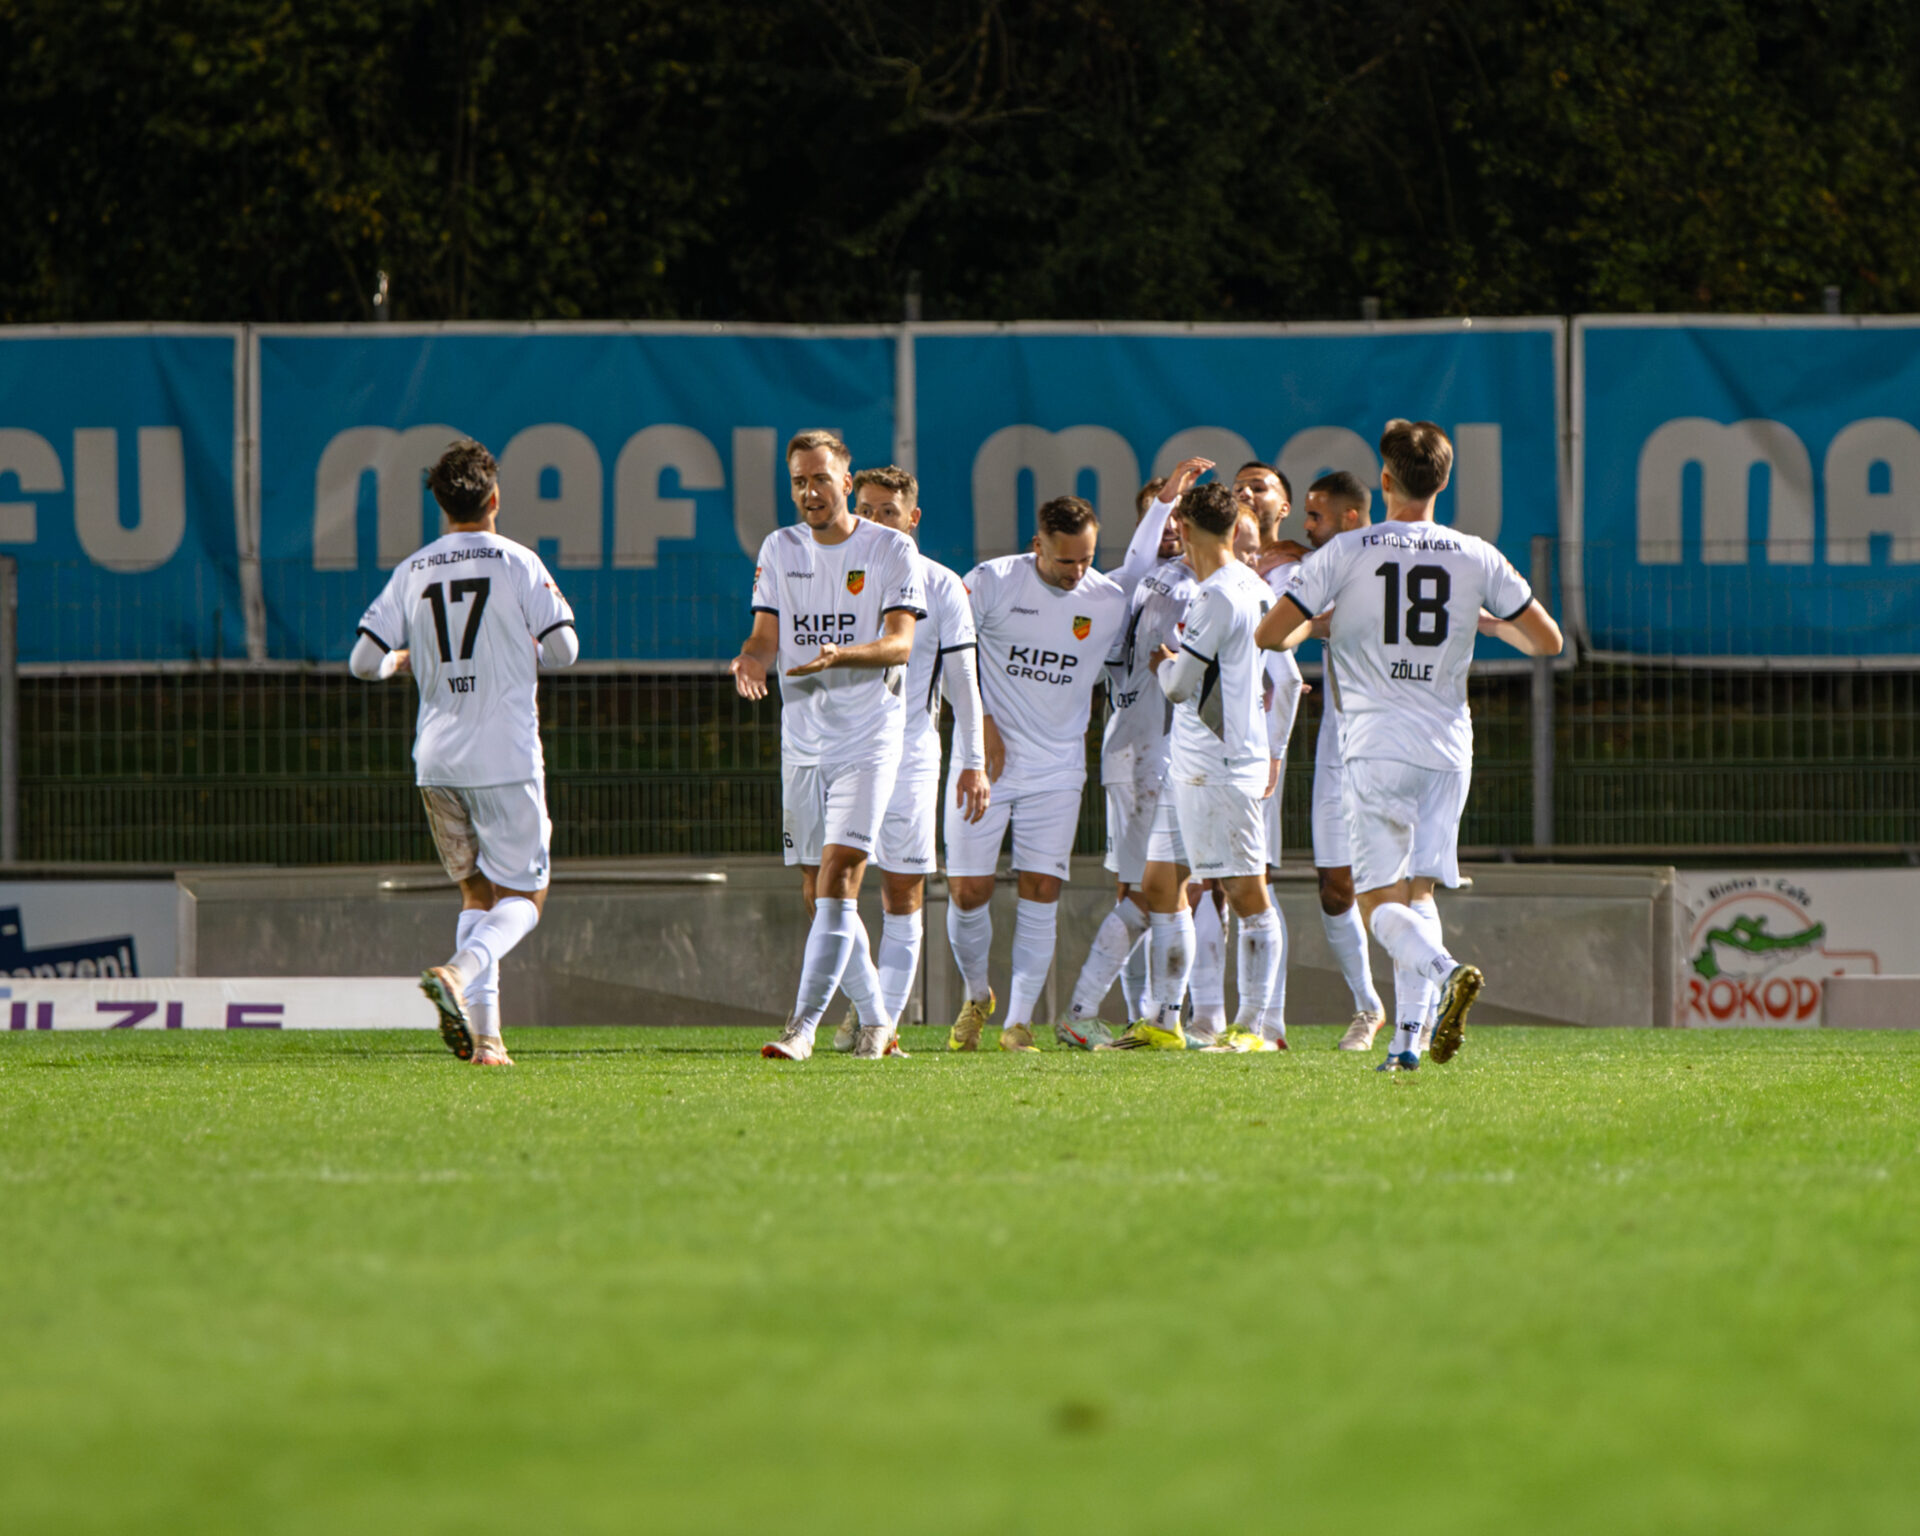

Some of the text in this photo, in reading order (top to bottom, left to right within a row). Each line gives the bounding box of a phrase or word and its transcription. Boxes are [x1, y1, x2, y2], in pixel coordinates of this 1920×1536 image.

[1362, 534, 1462, 551] FC HOLZHAUSEN
[411, 548, 504, 572] FC HOLZHAUSEN
[1375, 562, 1451, 647] 18
[421, 577, 490, 663] 17
[793, 613, 856, 632] KIPP
[794, 633, 855, 646] GROUP
[1009, 645, 1079, 670] KIPP
[1006, 664, 1073, 686] GROUP
[1391, 659, 1434, 682] ZÖLLE
[448, 676, 476, 694] VOGT
[1689, 976, 1822, 1021] ROKOD
